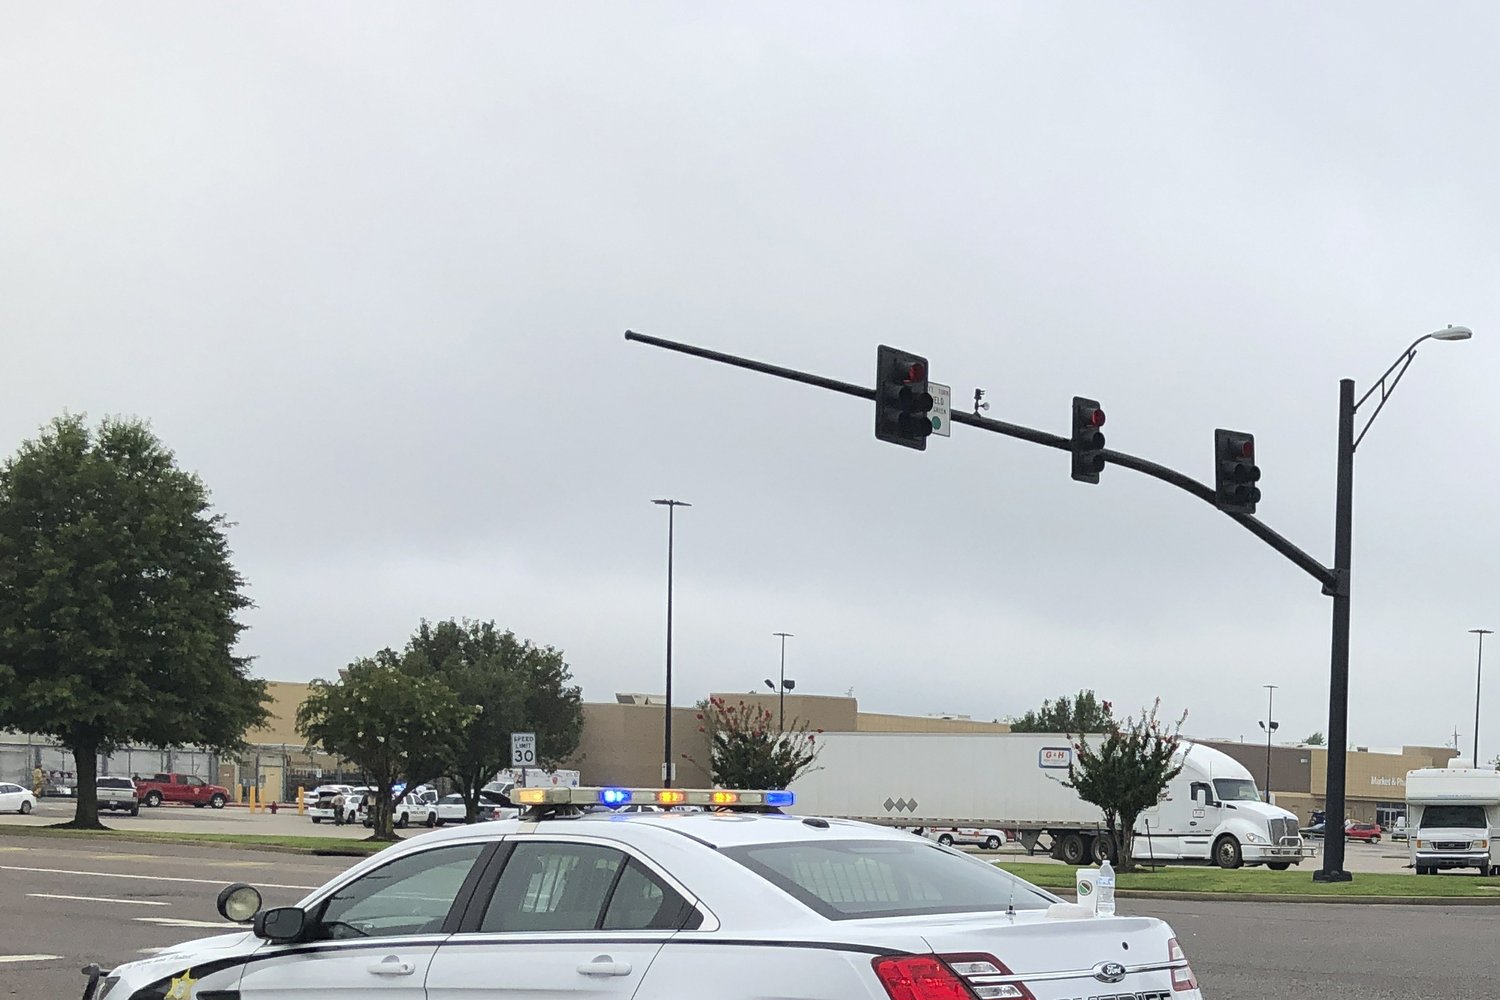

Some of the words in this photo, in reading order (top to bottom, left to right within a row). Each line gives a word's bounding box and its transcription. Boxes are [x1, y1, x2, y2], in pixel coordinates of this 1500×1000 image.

[514, 750, 534, 763] 30
[1371, 776, 1391, 786] Market
[1391, 777, 1397, 786] &
[1106, 964, 1122, 975] Ford
